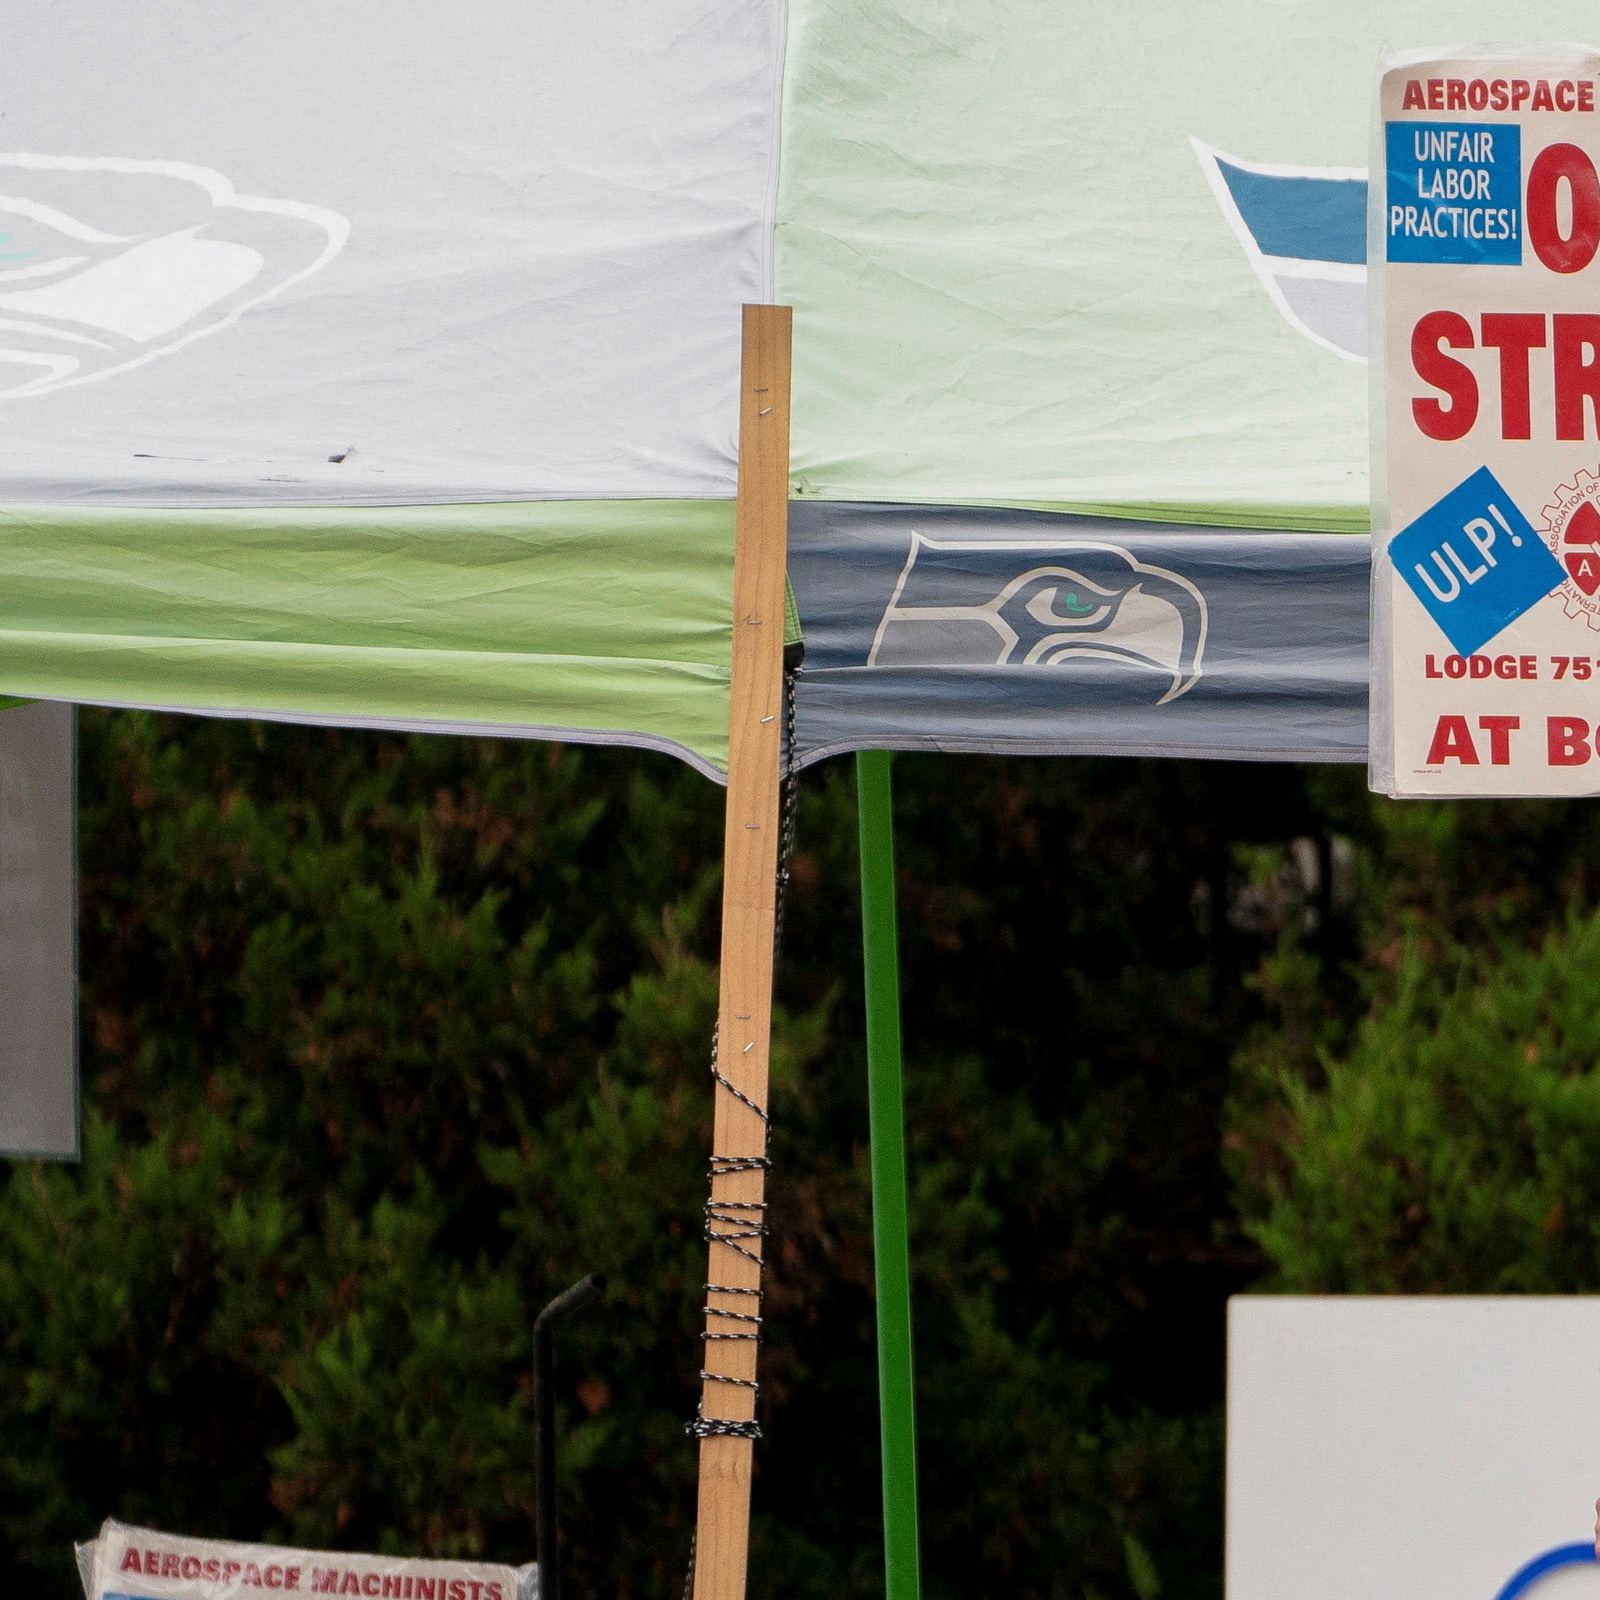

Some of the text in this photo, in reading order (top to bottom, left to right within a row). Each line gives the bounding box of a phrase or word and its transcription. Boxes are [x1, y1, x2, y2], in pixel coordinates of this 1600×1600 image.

[1402, 79, 1594, 112] AEROSPACE
[1414, 130, 1494, 163] UNFAIR
[1418, 169, 1490, 200] LABOR
[1391, 206, 1517, 240] PRACTICES!
[1414, 503, 1523, 603] ULP!
[1425, 654, 1537, 680] LODGE
[1425, 715, 1520, 766] AT
[119, 1547, 300, 1592] AEROSPACE
